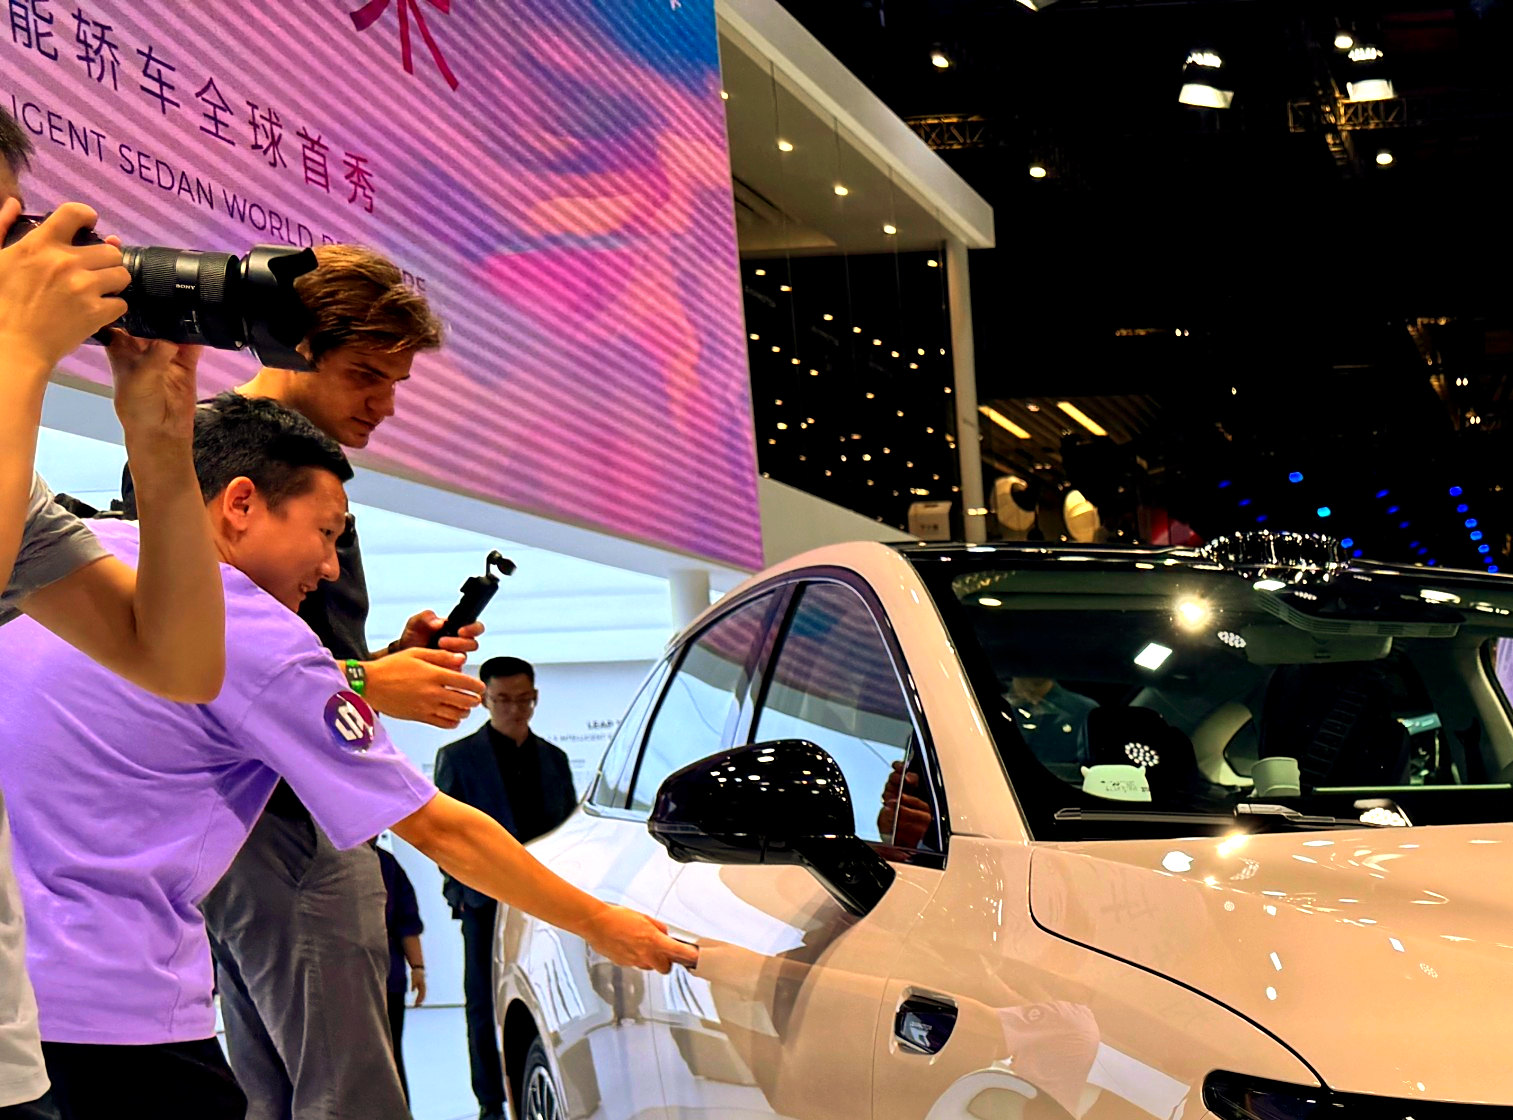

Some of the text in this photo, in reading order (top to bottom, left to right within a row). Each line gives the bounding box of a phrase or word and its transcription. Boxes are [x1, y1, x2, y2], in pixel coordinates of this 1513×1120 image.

[119, 144, 214, 210] SEDAN
[223, 189, 313, 248] WORLD
[175, 283, 196, 291] SONY
